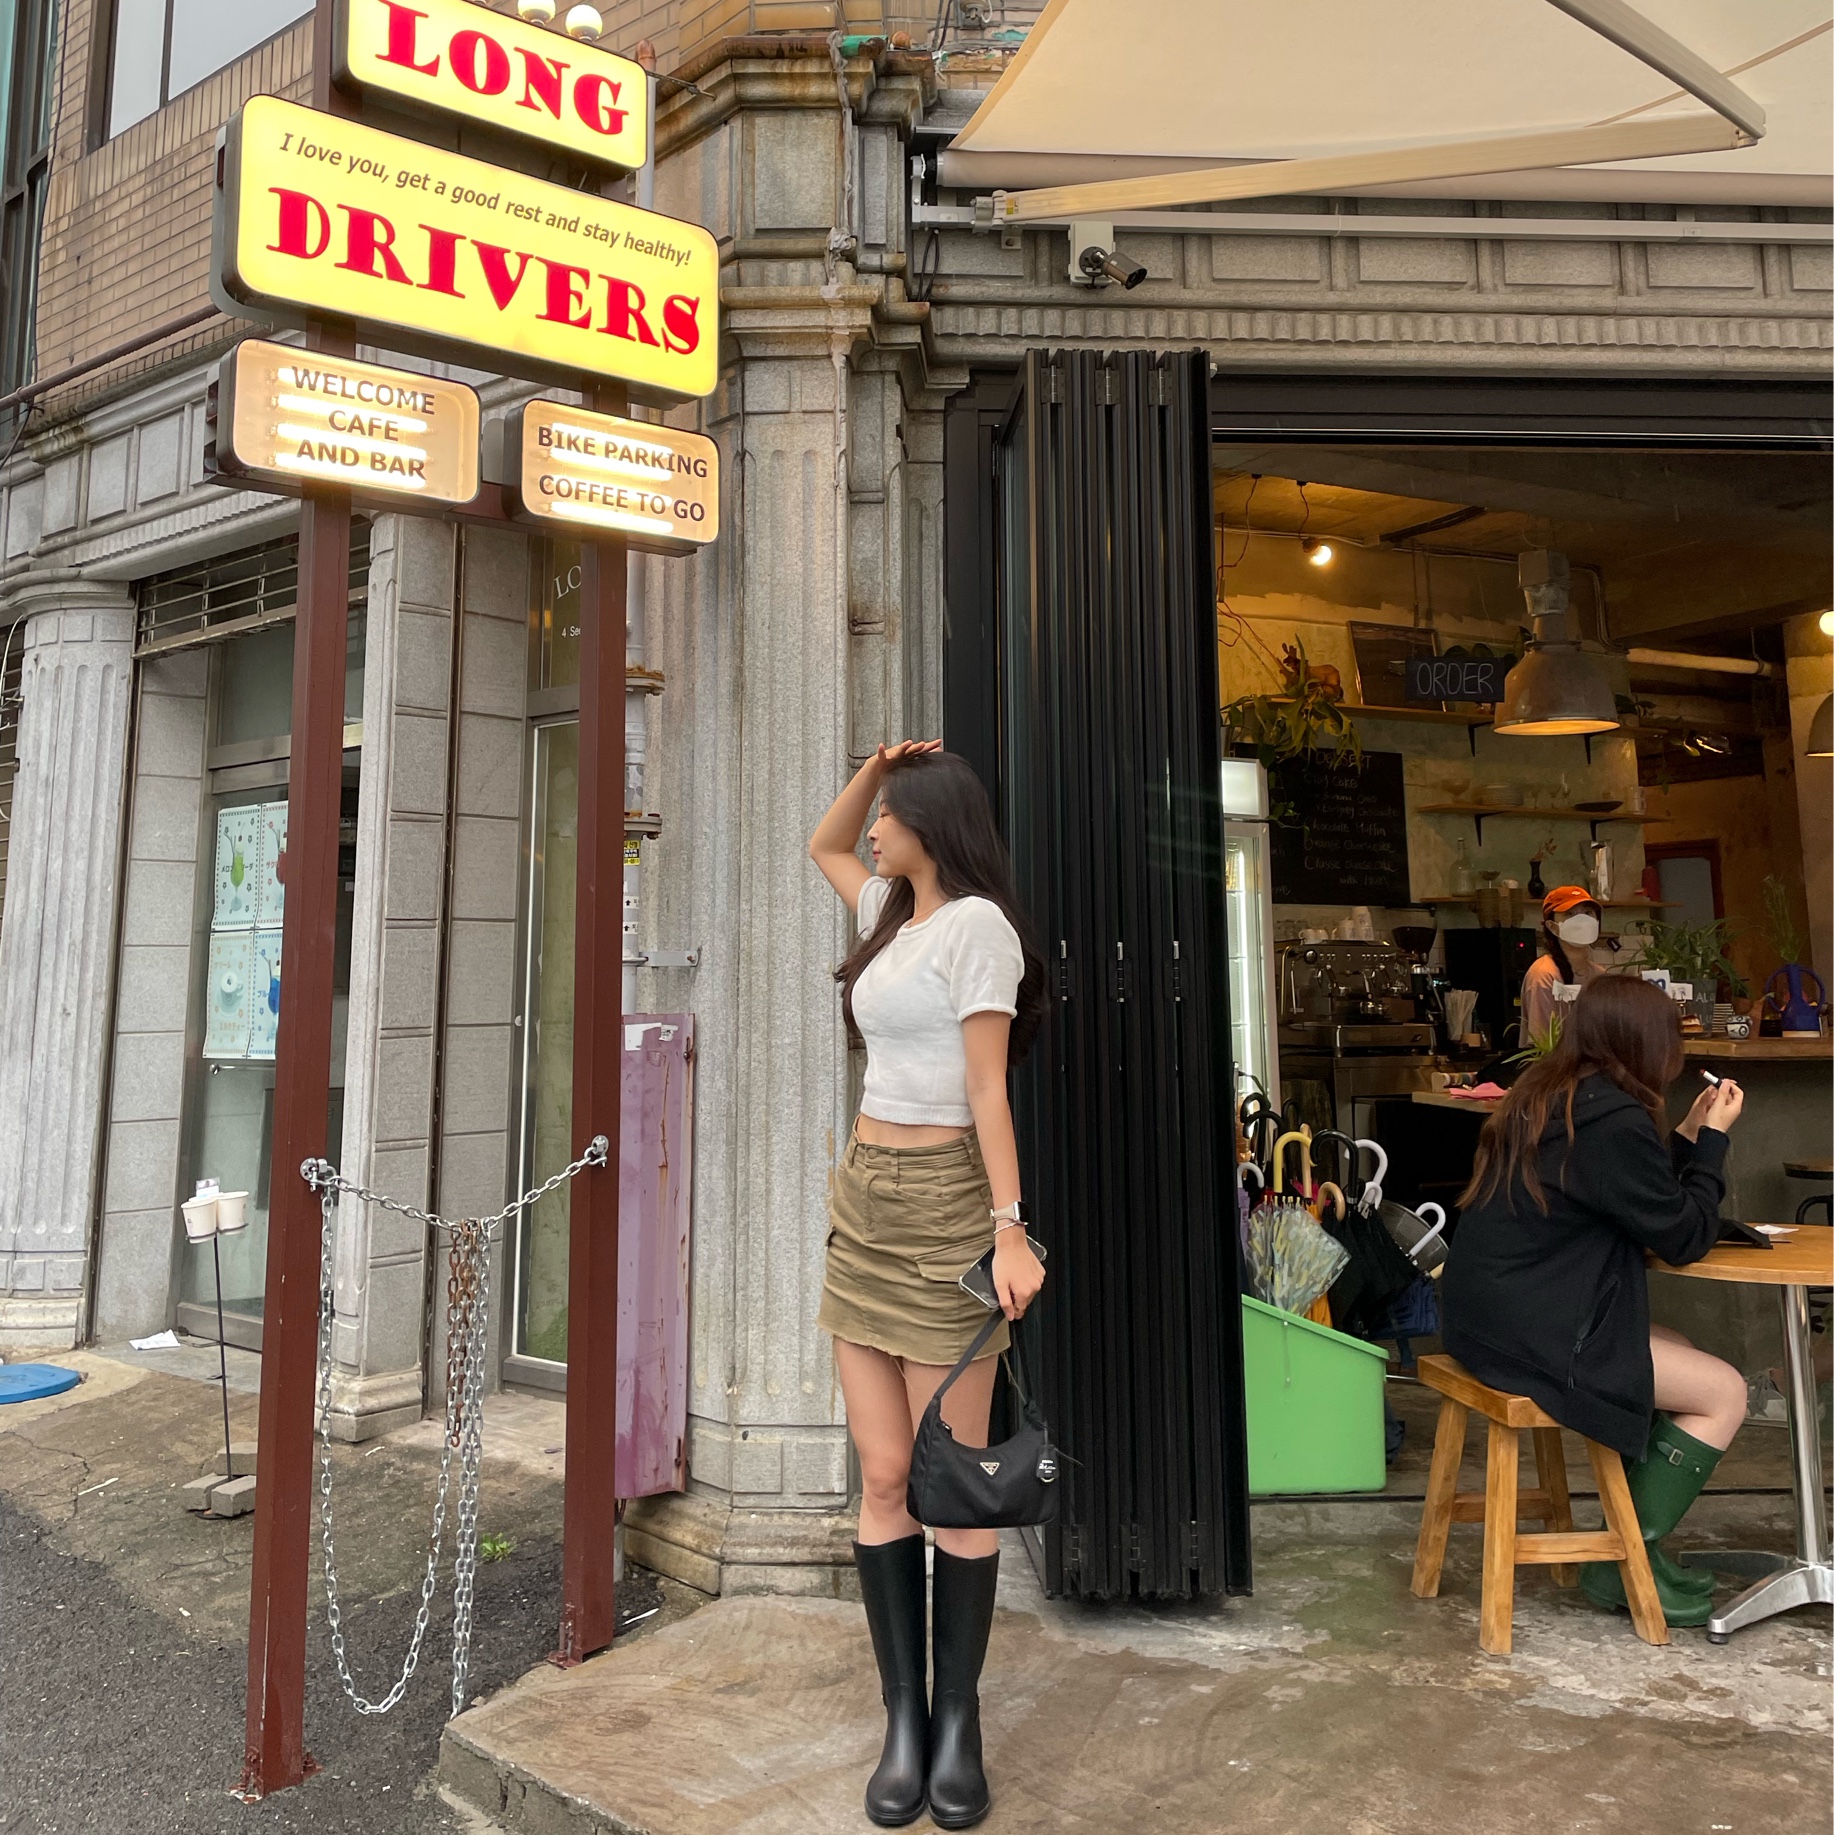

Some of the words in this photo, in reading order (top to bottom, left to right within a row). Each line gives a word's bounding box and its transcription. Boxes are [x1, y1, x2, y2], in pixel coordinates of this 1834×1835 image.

[377, 0, 628, 135] LONG
[280, 132, 293, 151] I
[296, 137, 342, 165] love
[346, 155, 390, 183] you,
[395, 170, 431, 188] get
[434, 181, 447, 195] a
[451, 186, 500, 210] good
[505, 201, 543, 223] rest
[545, 212, 580, 233] and
[583, 223, 620, 248] stay
[623, 231, 691, 267] healthy!
[267, 187, 701, 356] DRIVERS
[291, 366, 435, 415] WELCOME
[328, 410, 399, 441] CAFE
[296, 439, 360, 467] AND
[370, 451, 426, 480] BAR
[538, 426, 596, 456] BIKE
[604, 440, 708, 478] PARKING
[539, 474, 628, 508] COFFEE
[636, 492, 666, 515] TO
[673, 499, 705, 521] GO
[1416, 662, 1494, 696] ORDER
